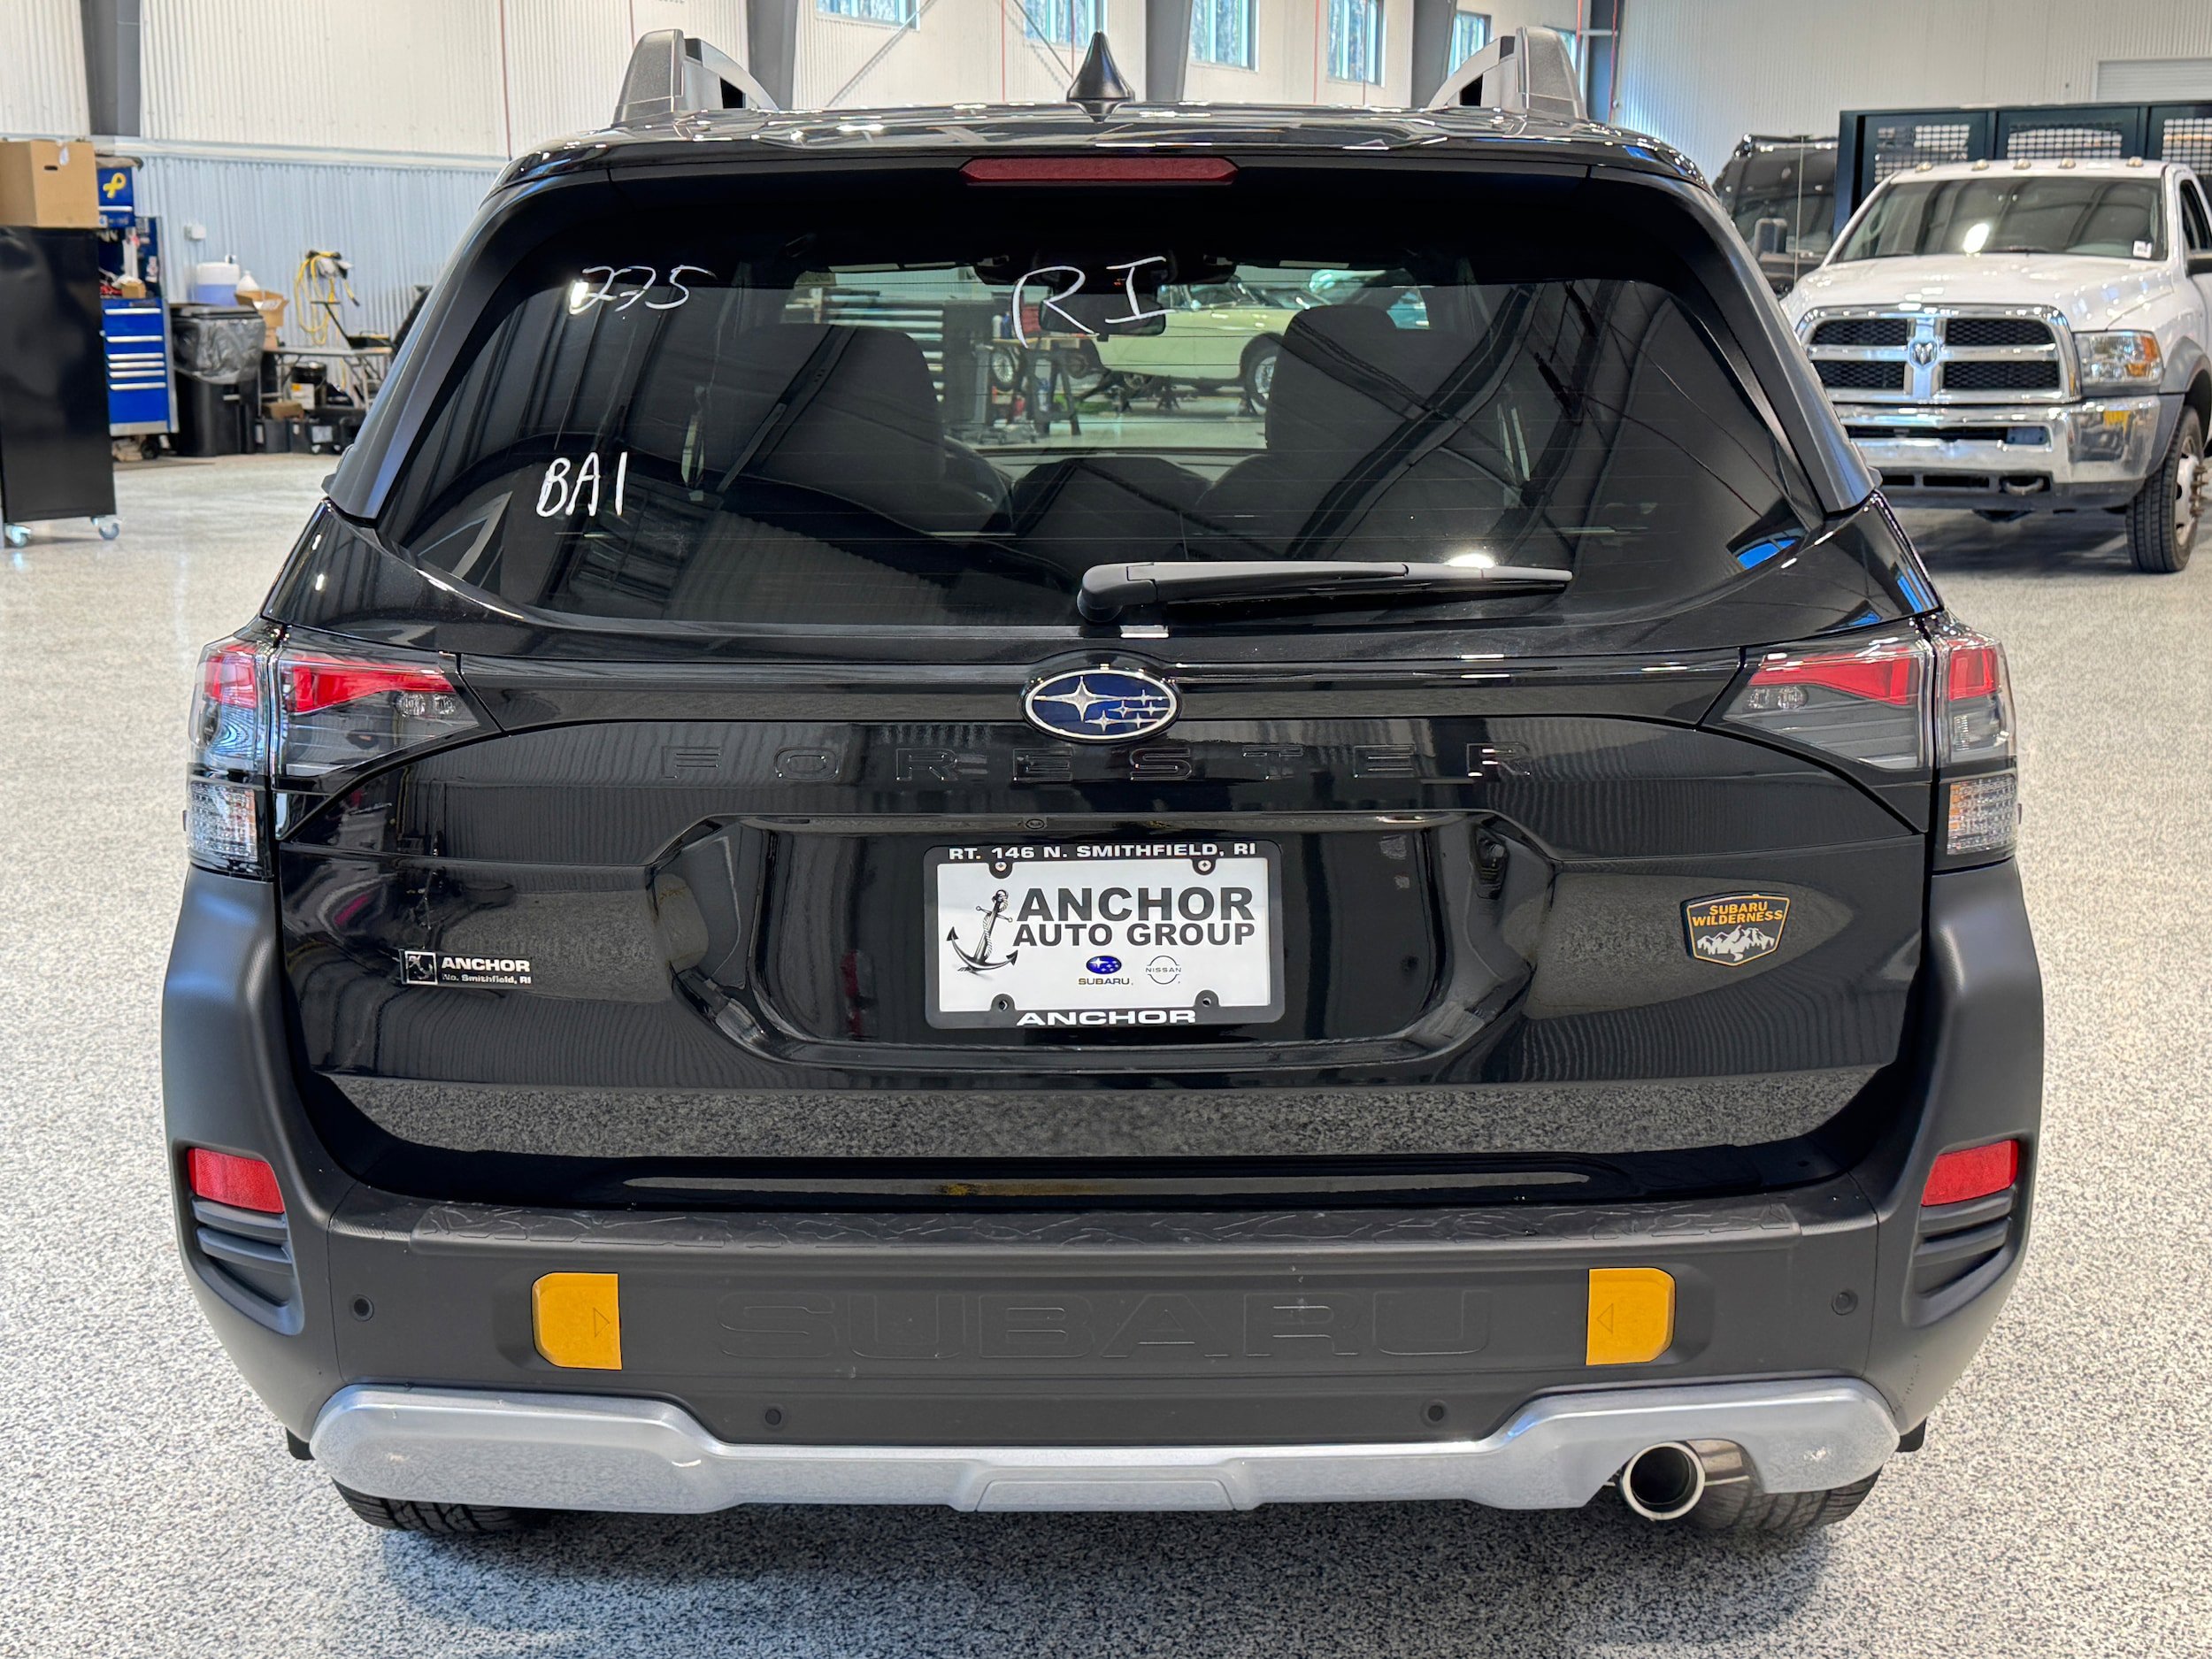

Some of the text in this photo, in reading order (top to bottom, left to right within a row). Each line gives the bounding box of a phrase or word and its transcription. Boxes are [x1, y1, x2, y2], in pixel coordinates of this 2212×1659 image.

[1012, 255, 1177, 349] RI
[660, 741, 1532, 783] FORESTER
[949, 842, 1256, 860] RT. 146 N. SMITHFIELD, RI
[1016, 887, 1256, 922] ANCHOR
[1709, 901, 1768, 916] SUBARU
[1692, 910, 1784, 927] WILDERNESS
[1012, 922, 1256, 947] AUTO GROUP
[442, 956, 530, 972] ANCHOR
[519, 976, 532, 985] RI
[1078, 977, 1131, 987] SUBARU
[1016, 1009, 1196, 1027] ANCHOR
[717, 1288, 1493, 1361] SUBARU
